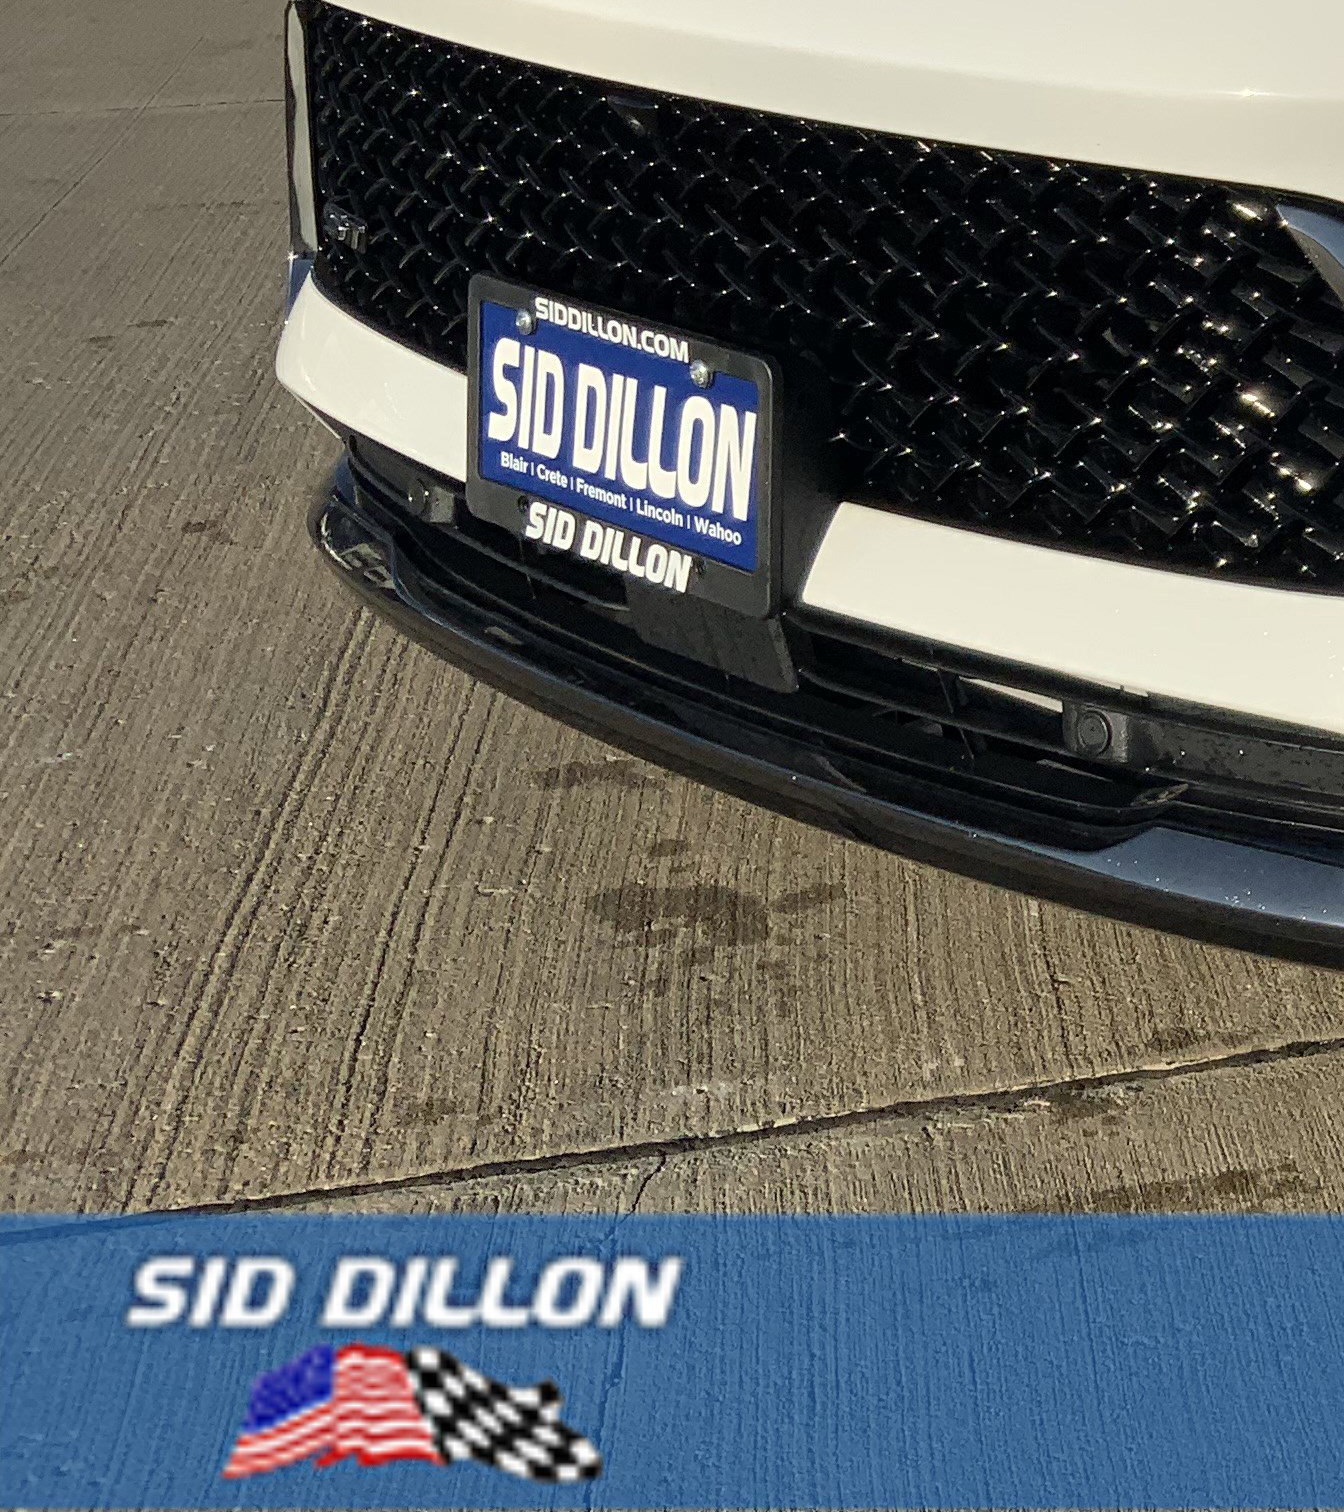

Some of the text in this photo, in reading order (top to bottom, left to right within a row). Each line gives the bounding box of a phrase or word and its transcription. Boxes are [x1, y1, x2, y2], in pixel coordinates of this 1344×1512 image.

[534, 296, 690, 364] SIDDILLON.COM
[487, 336, 758, 522] SID DILLON
[500, 451, 529, 474] Blair
[536, 464, 569, 489] Crete
[575, 478, 628, 510] Fremont
[635, 497, 684, 528] Lincoln
[693, 515, 742, 546] Wahoo
[524, 501, 693, 594] SID DILLON
